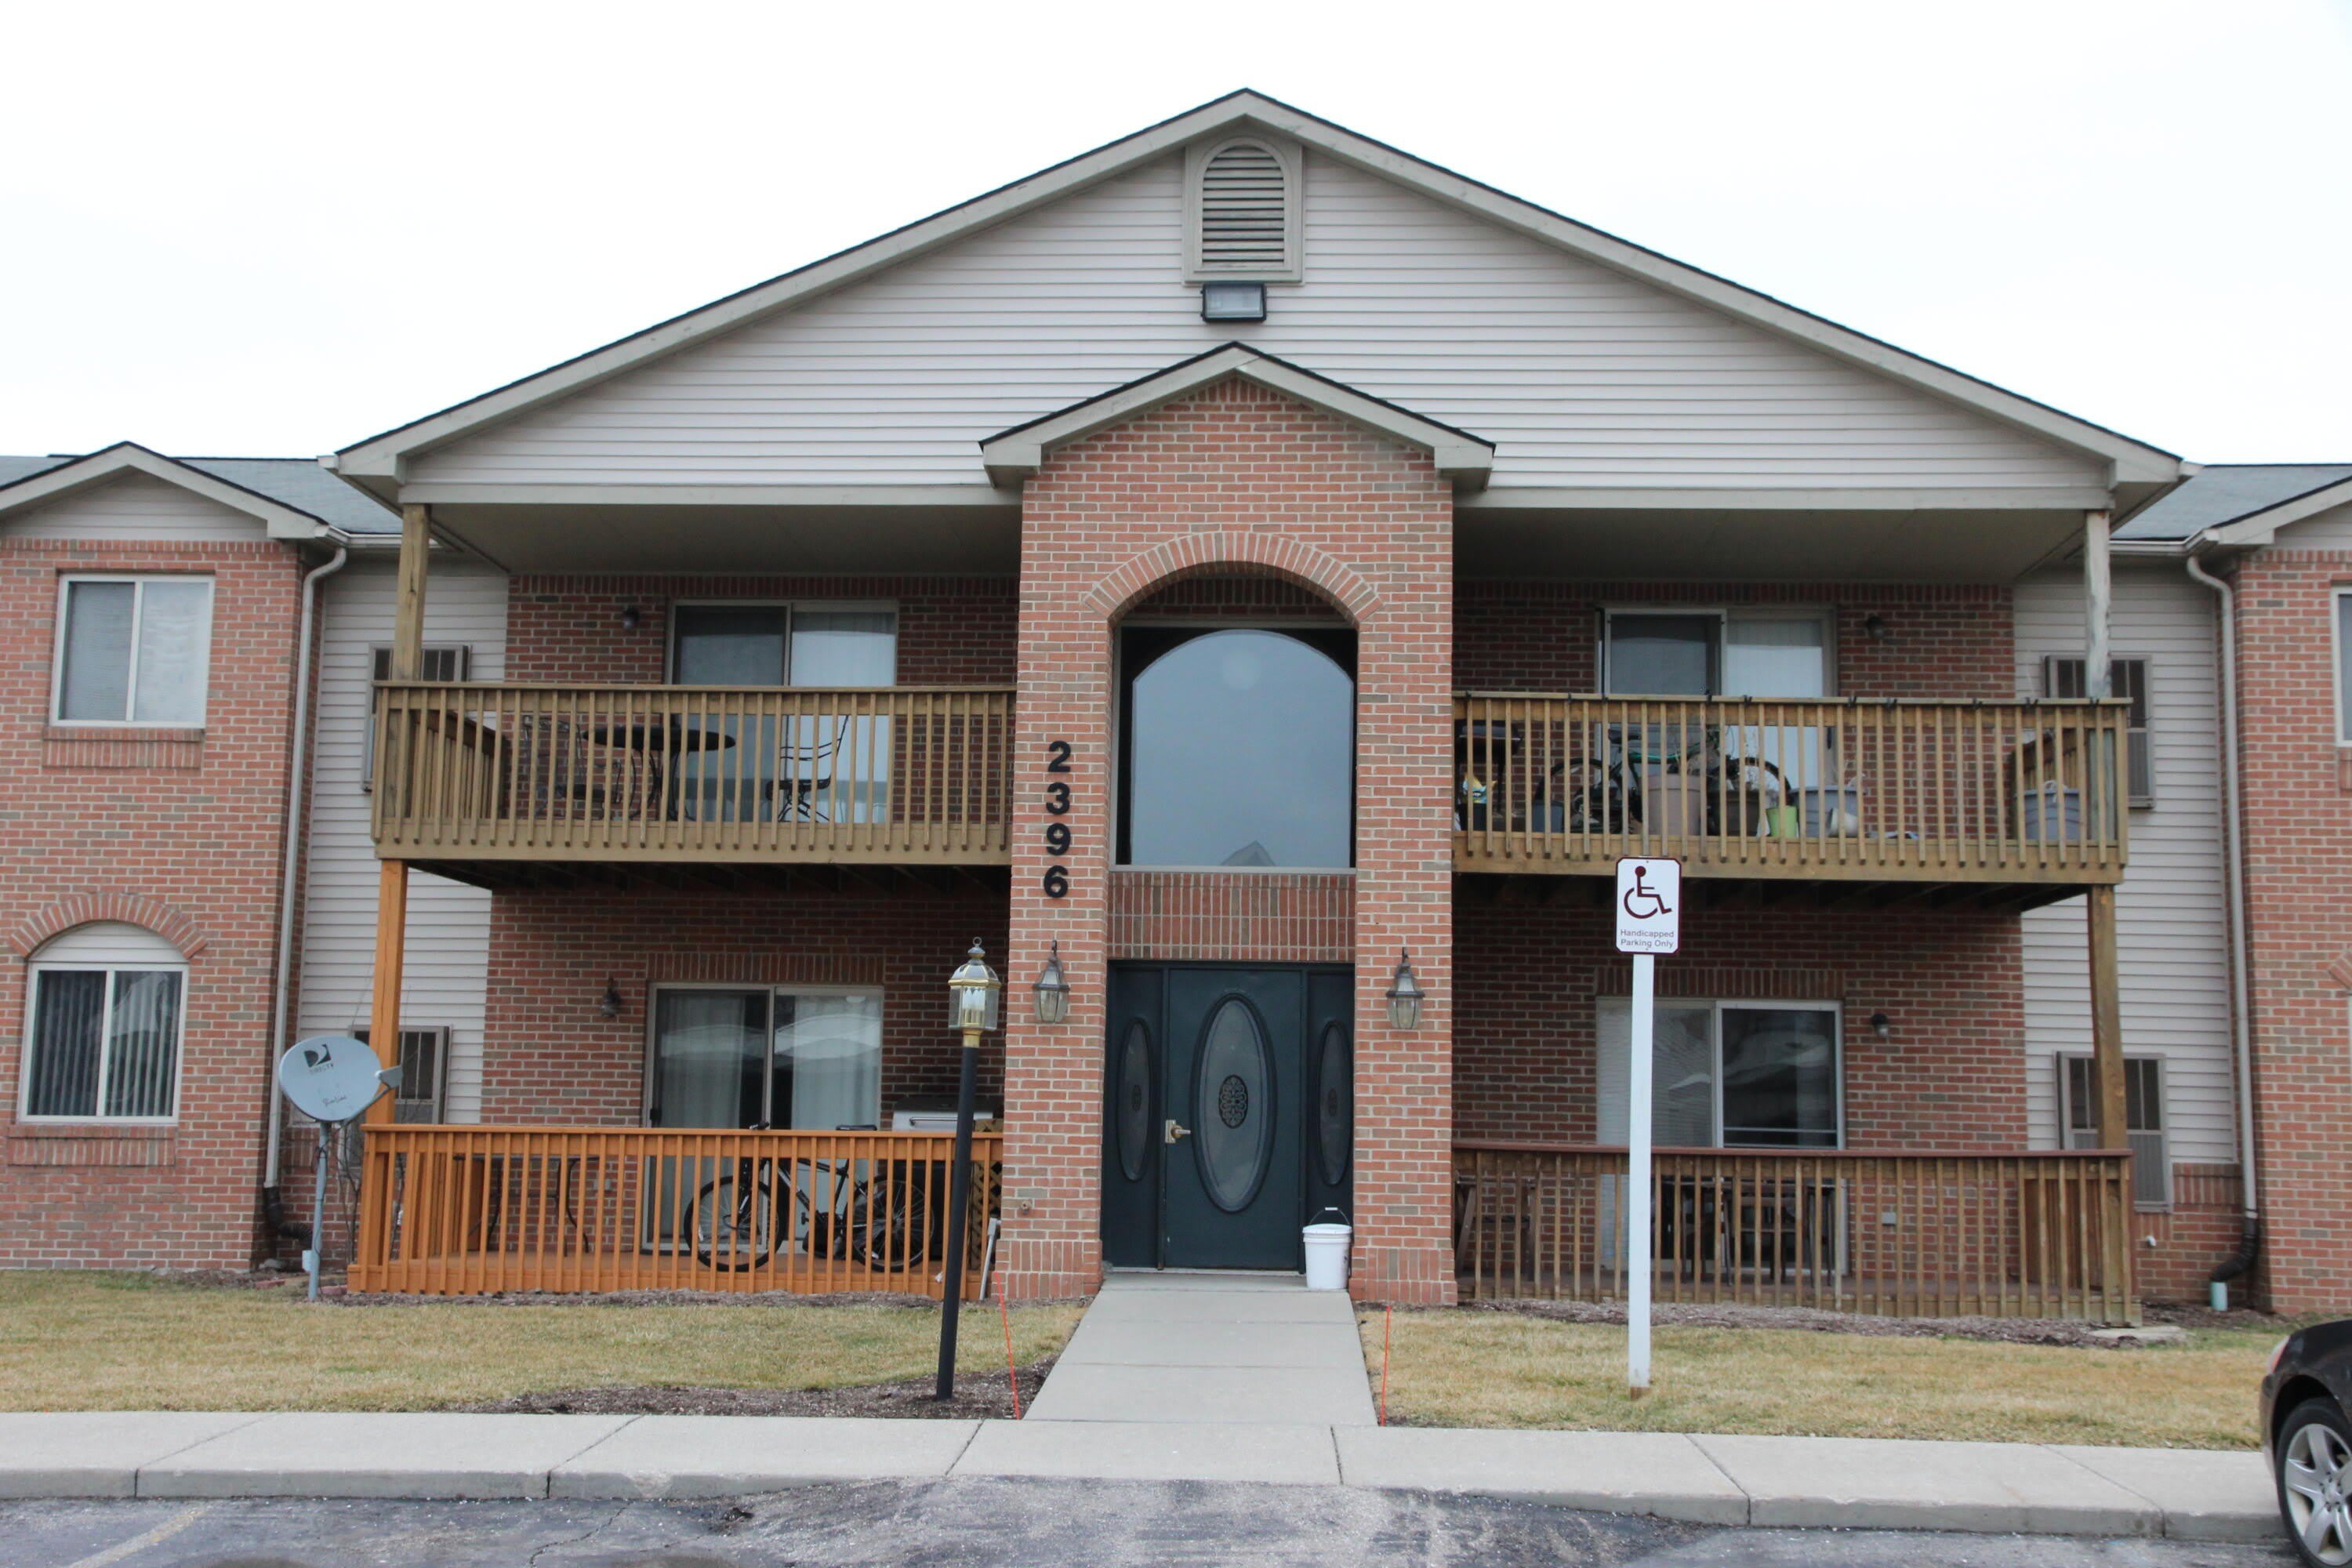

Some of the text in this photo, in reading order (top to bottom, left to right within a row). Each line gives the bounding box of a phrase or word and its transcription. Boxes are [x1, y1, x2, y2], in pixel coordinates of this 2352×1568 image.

[1044, 740, 1071, 898] 2396
[1621, 929, 1674, 938] Handicapped
[1621, 939, 1674, 948] Parking Only
